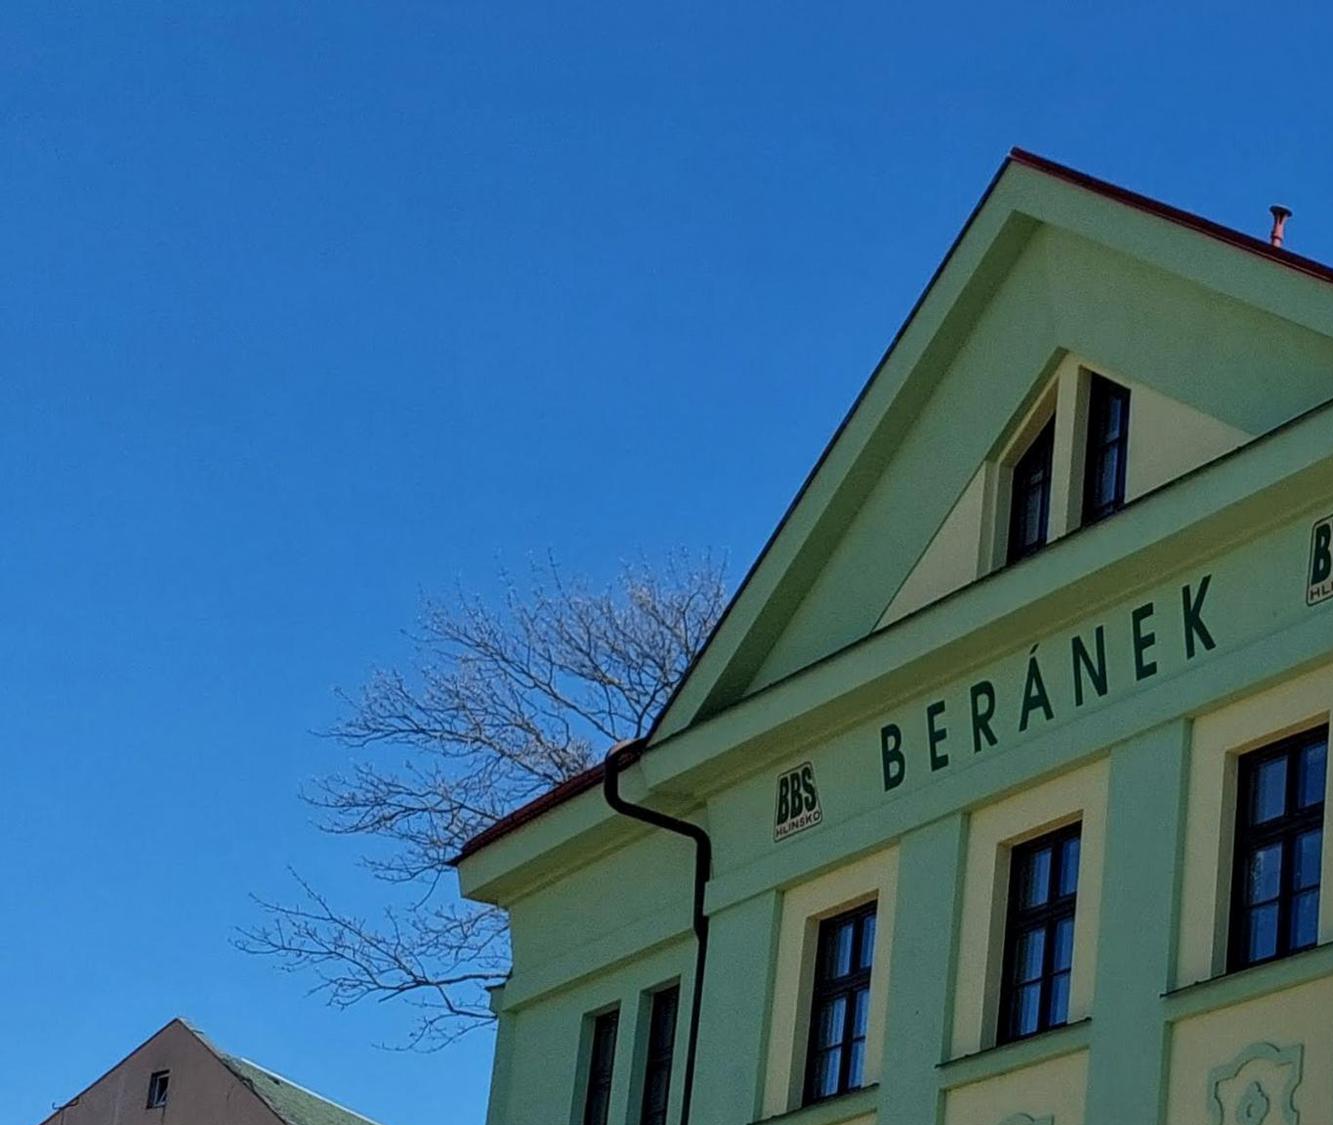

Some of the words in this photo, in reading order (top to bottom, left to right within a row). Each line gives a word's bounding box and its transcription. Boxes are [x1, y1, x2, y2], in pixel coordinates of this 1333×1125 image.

[881, 574, 1216, 792] BERÁNEK
[776, 811, 820, 838] HLINSKO
[777, 766, 817, 826] BBS
